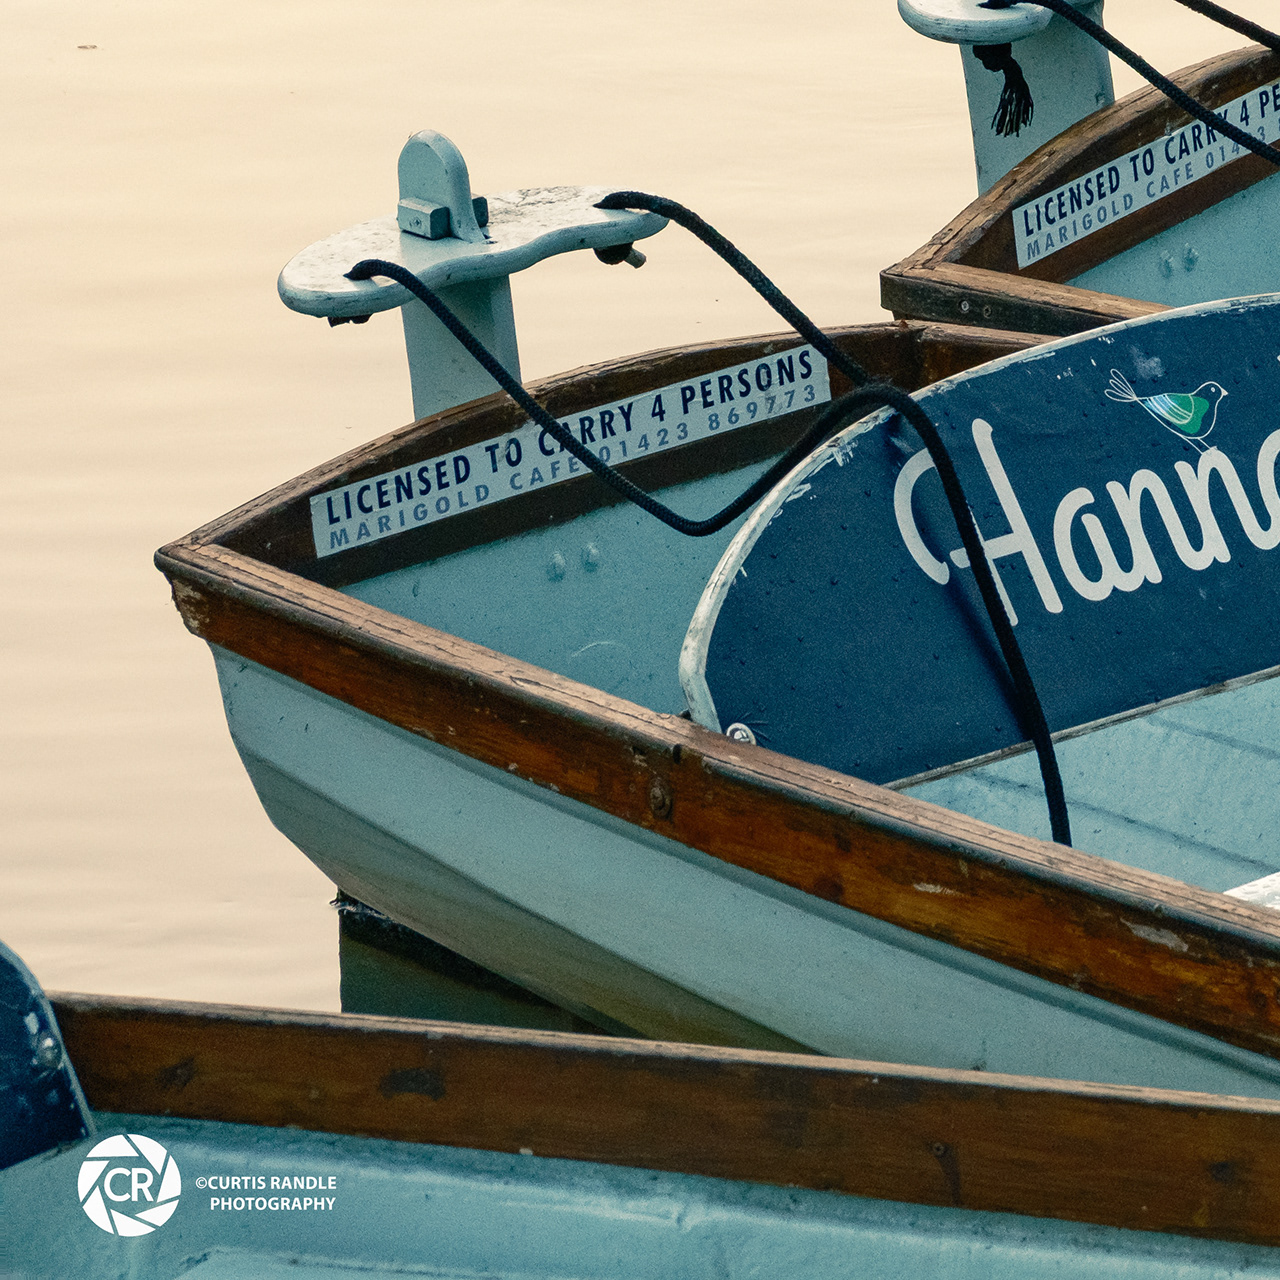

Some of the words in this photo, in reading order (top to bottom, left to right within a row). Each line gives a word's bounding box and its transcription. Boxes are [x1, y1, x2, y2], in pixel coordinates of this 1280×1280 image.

[1023, 164, 1121, 238] LICENSED
[1129, 148, 1155, 183] TO
[1239, 99, 1250, 127] 4
[1026, 193, 1135, 261] MARIGOLD
[1146, 161, 1195, 198] CAFE
[1205, 126, 1266, 169] 0143
[326, 454, 471, 527] LICENSED
[485, 437, 523, 474] TO
[651, 393, 666, 422] 4
[680, 349, 813, 415] PERSONS
[329, 483, 490, 550] MARIGOLD
[509, 456, 580, 491] CAFE
[598, 422, 689, 465] 01423
[707, 383, 818, 432] 869773
